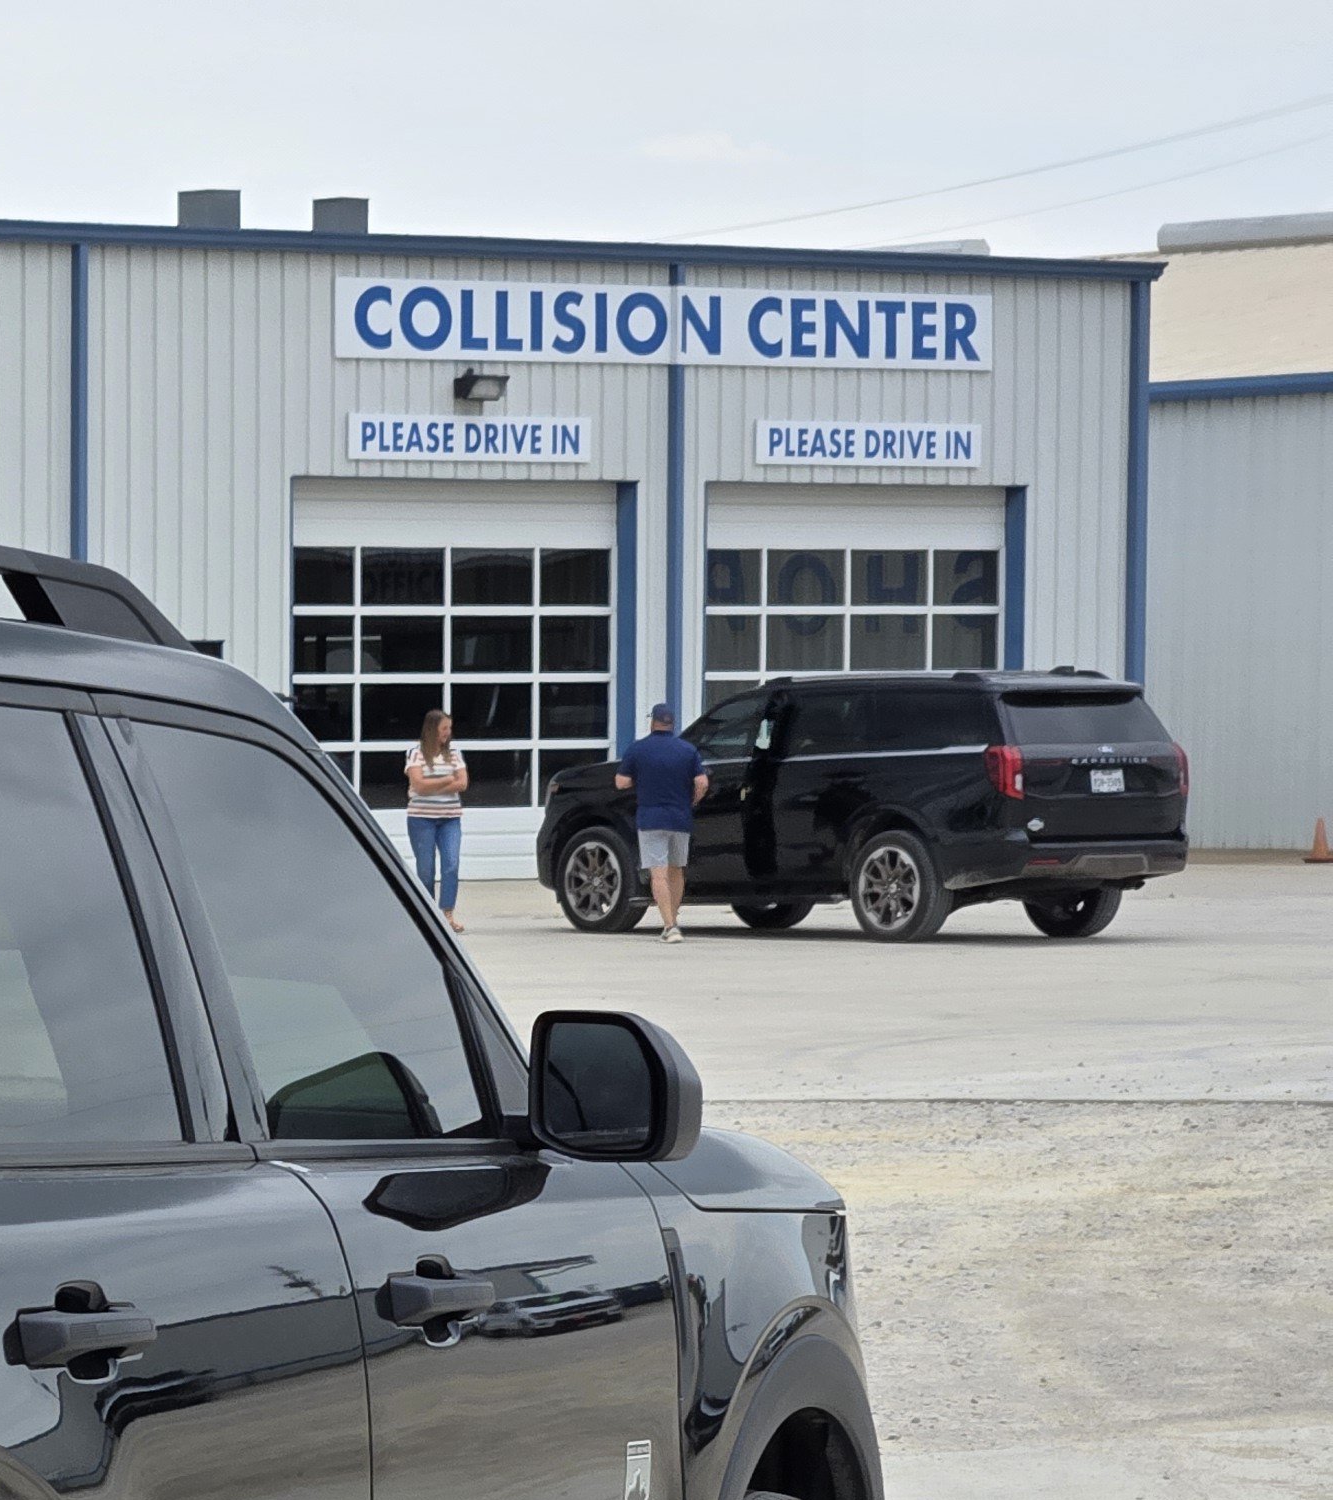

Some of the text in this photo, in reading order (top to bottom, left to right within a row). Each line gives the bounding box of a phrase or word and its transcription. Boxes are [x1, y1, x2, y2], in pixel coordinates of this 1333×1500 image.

[353, 285, 979, 362] COLLISION CENTER
[360, 420, 580, 456] PLEASE DRIVE IN
[768, 427, 972, 461] PLEASE DRIVE IN
